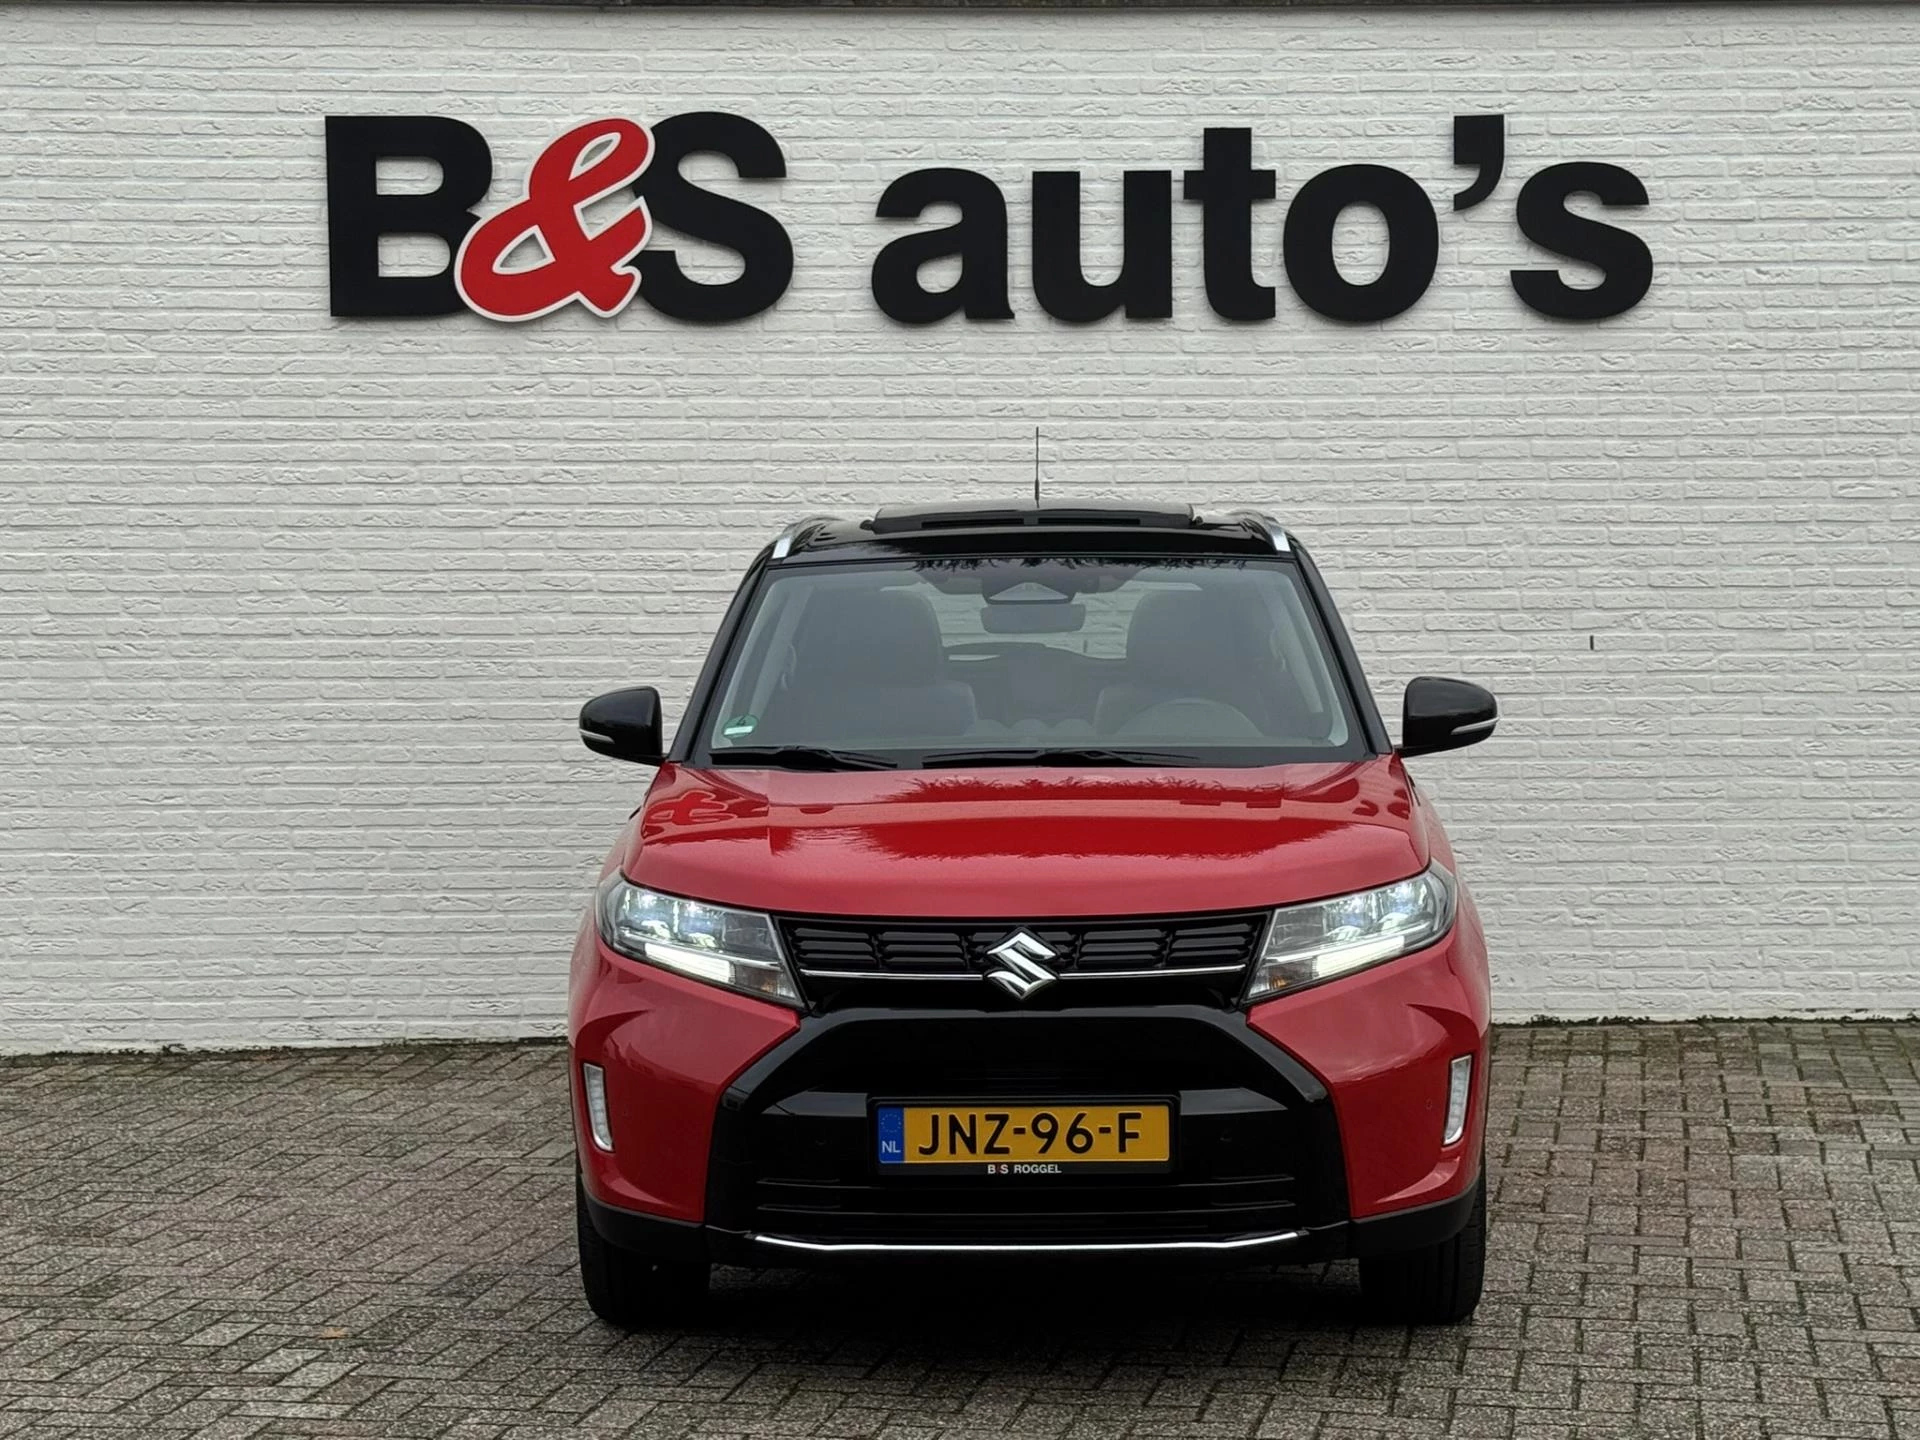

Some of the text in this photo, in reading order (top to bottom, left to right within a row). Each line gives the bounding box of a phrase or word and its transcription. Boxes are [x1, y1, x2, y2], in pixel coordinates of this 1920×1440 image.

[325, 111, 1654, 324] B&S auto's
[881, 1140, 901, 1154] NL
[918, 1112, 1142, 1156] JNZ-96-F
[1013, 1164, 1063, 1174] ROGGEL
